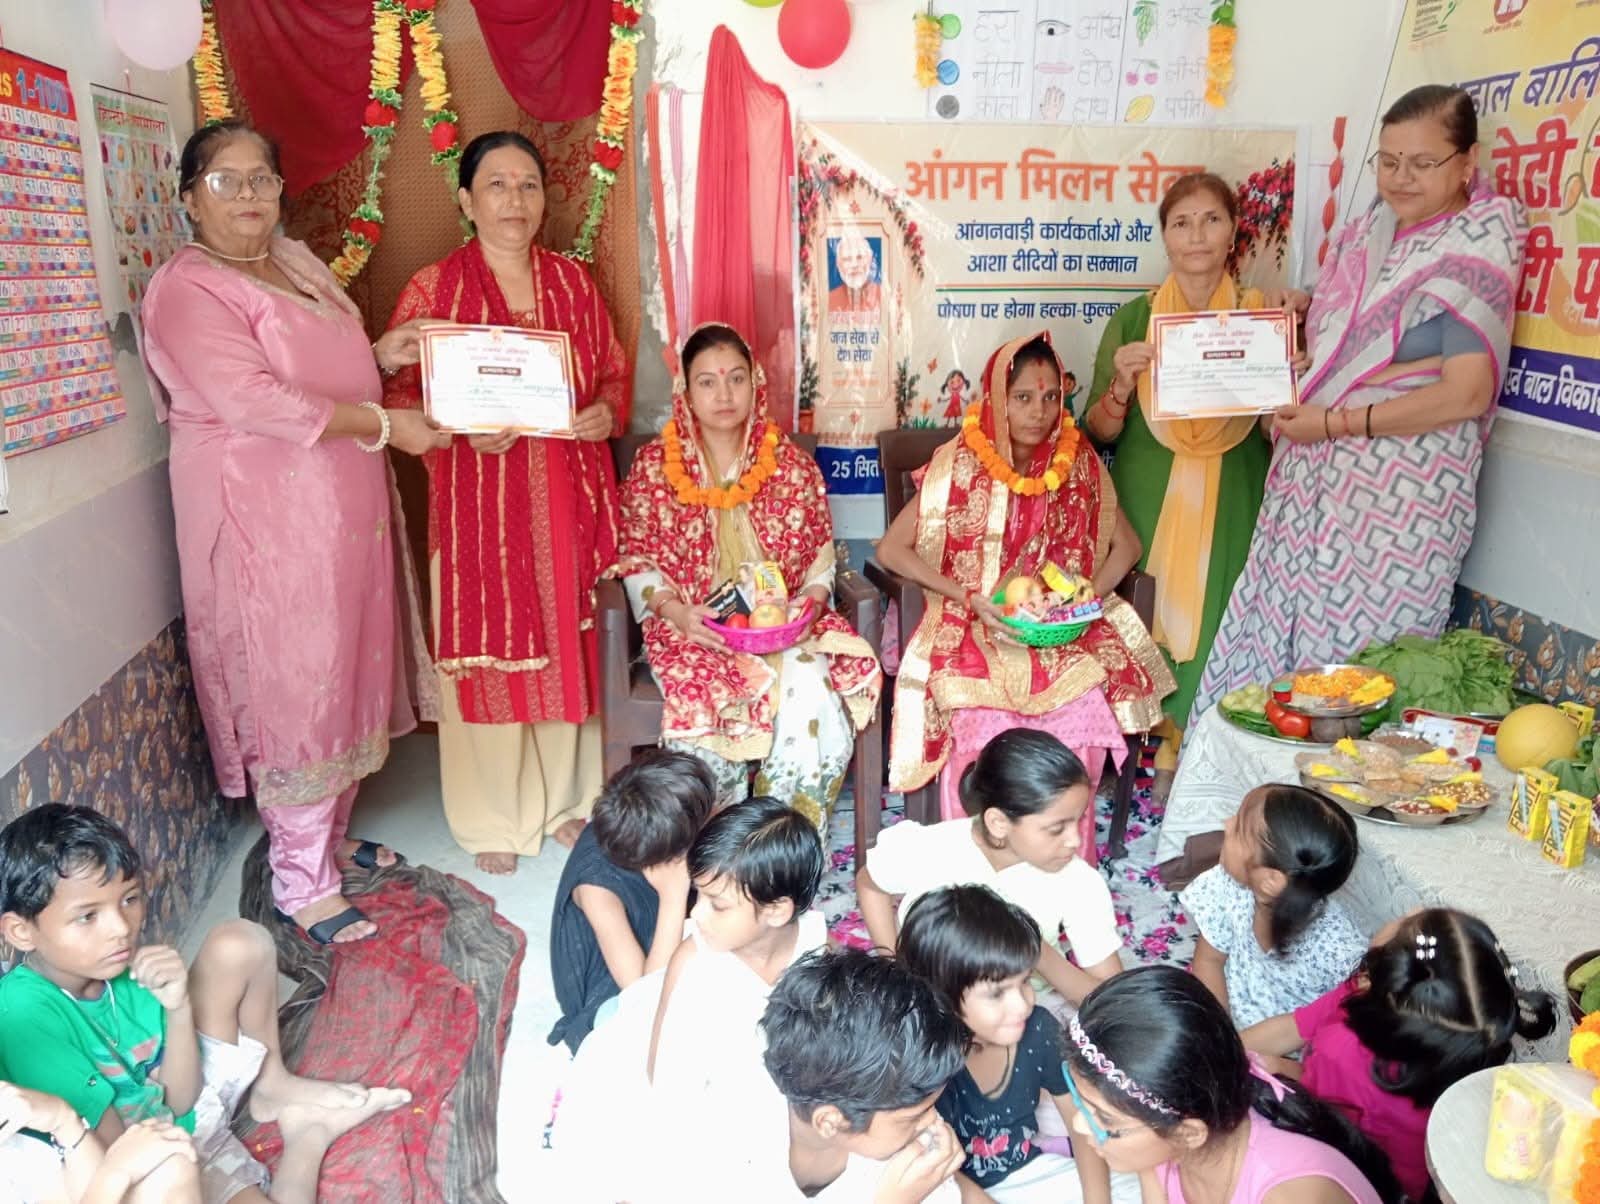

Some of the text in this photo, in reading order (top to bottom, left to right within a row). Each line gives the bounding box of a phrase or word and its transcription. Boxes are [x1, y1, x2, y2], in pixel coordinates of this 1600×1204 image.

[0, 72, 13, 97] S
[905, 148, 1206, 203] आंगन मिलन से
[1491, 118, 1579, 208] बेटी
[955, 216, 1153, 244] आंगनवाड़ी कार्यकर्ताओं और
[967, 248, 1138, 273] आशा दीदियों का सम्मान
[1514, 225, 1564, 315] टी
[937, 297, 1121, 324] पोषण पर होगा हल्का-फुल्क
[1523, 370, 1558, 404] बाल
[831, 460, 851, 479] 25
